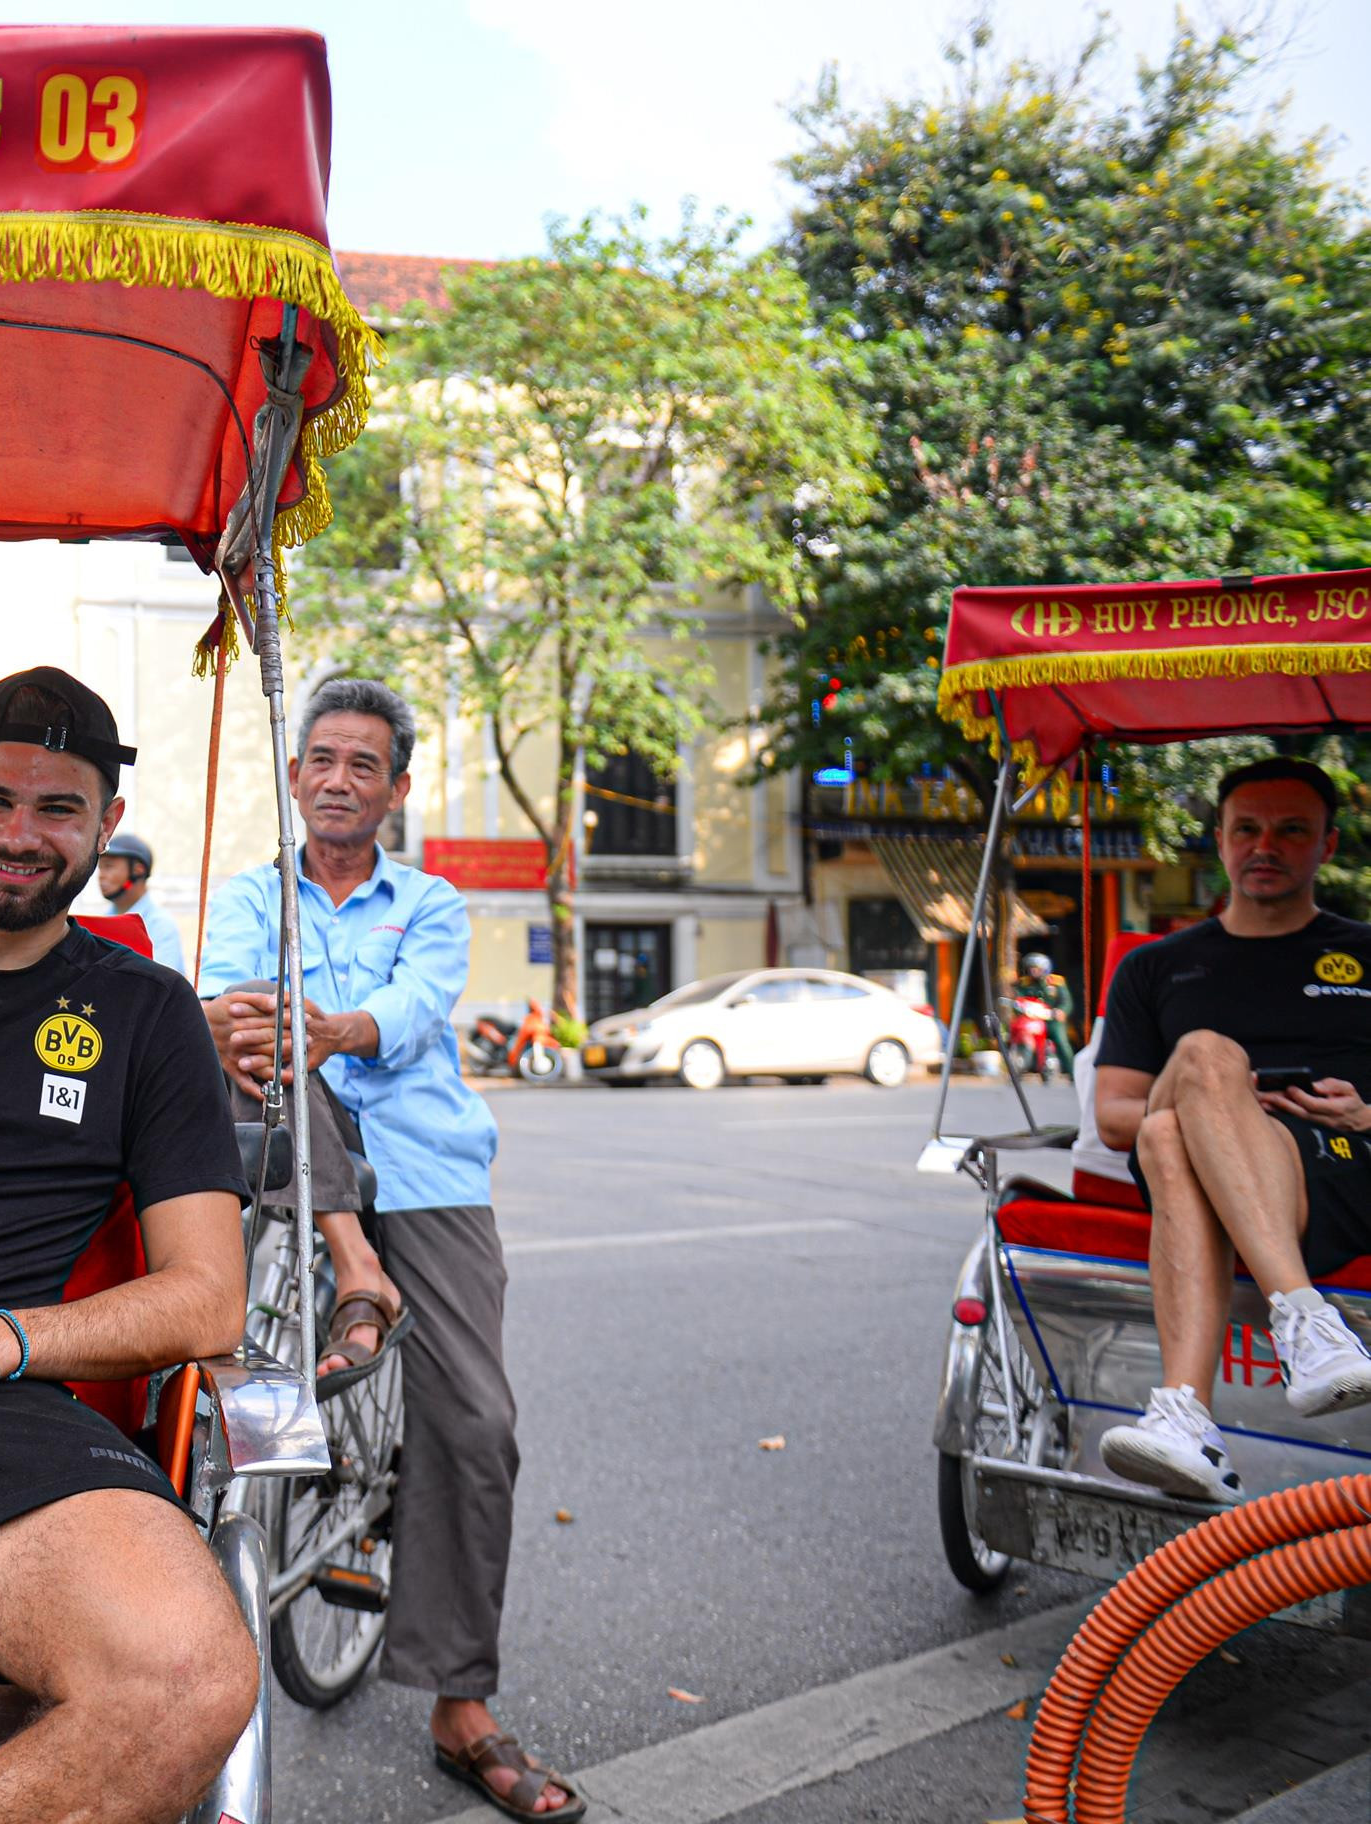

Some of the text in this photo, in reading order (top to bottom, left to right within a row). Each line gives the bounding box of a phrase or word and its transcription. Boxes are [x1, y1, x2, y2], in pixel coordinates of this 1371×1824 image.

[39, 73, 138, 163] 03
[1093, 600, 1159, 634] HUY
[1307, 587, 1370, 623] JSC
[1322, 956, 1356, 976] BVB
[44, 1020, 95, 1059] BVB
[57, 1053, 76, 1067] 09
[47, 1084, 80, 1110] 1&1
